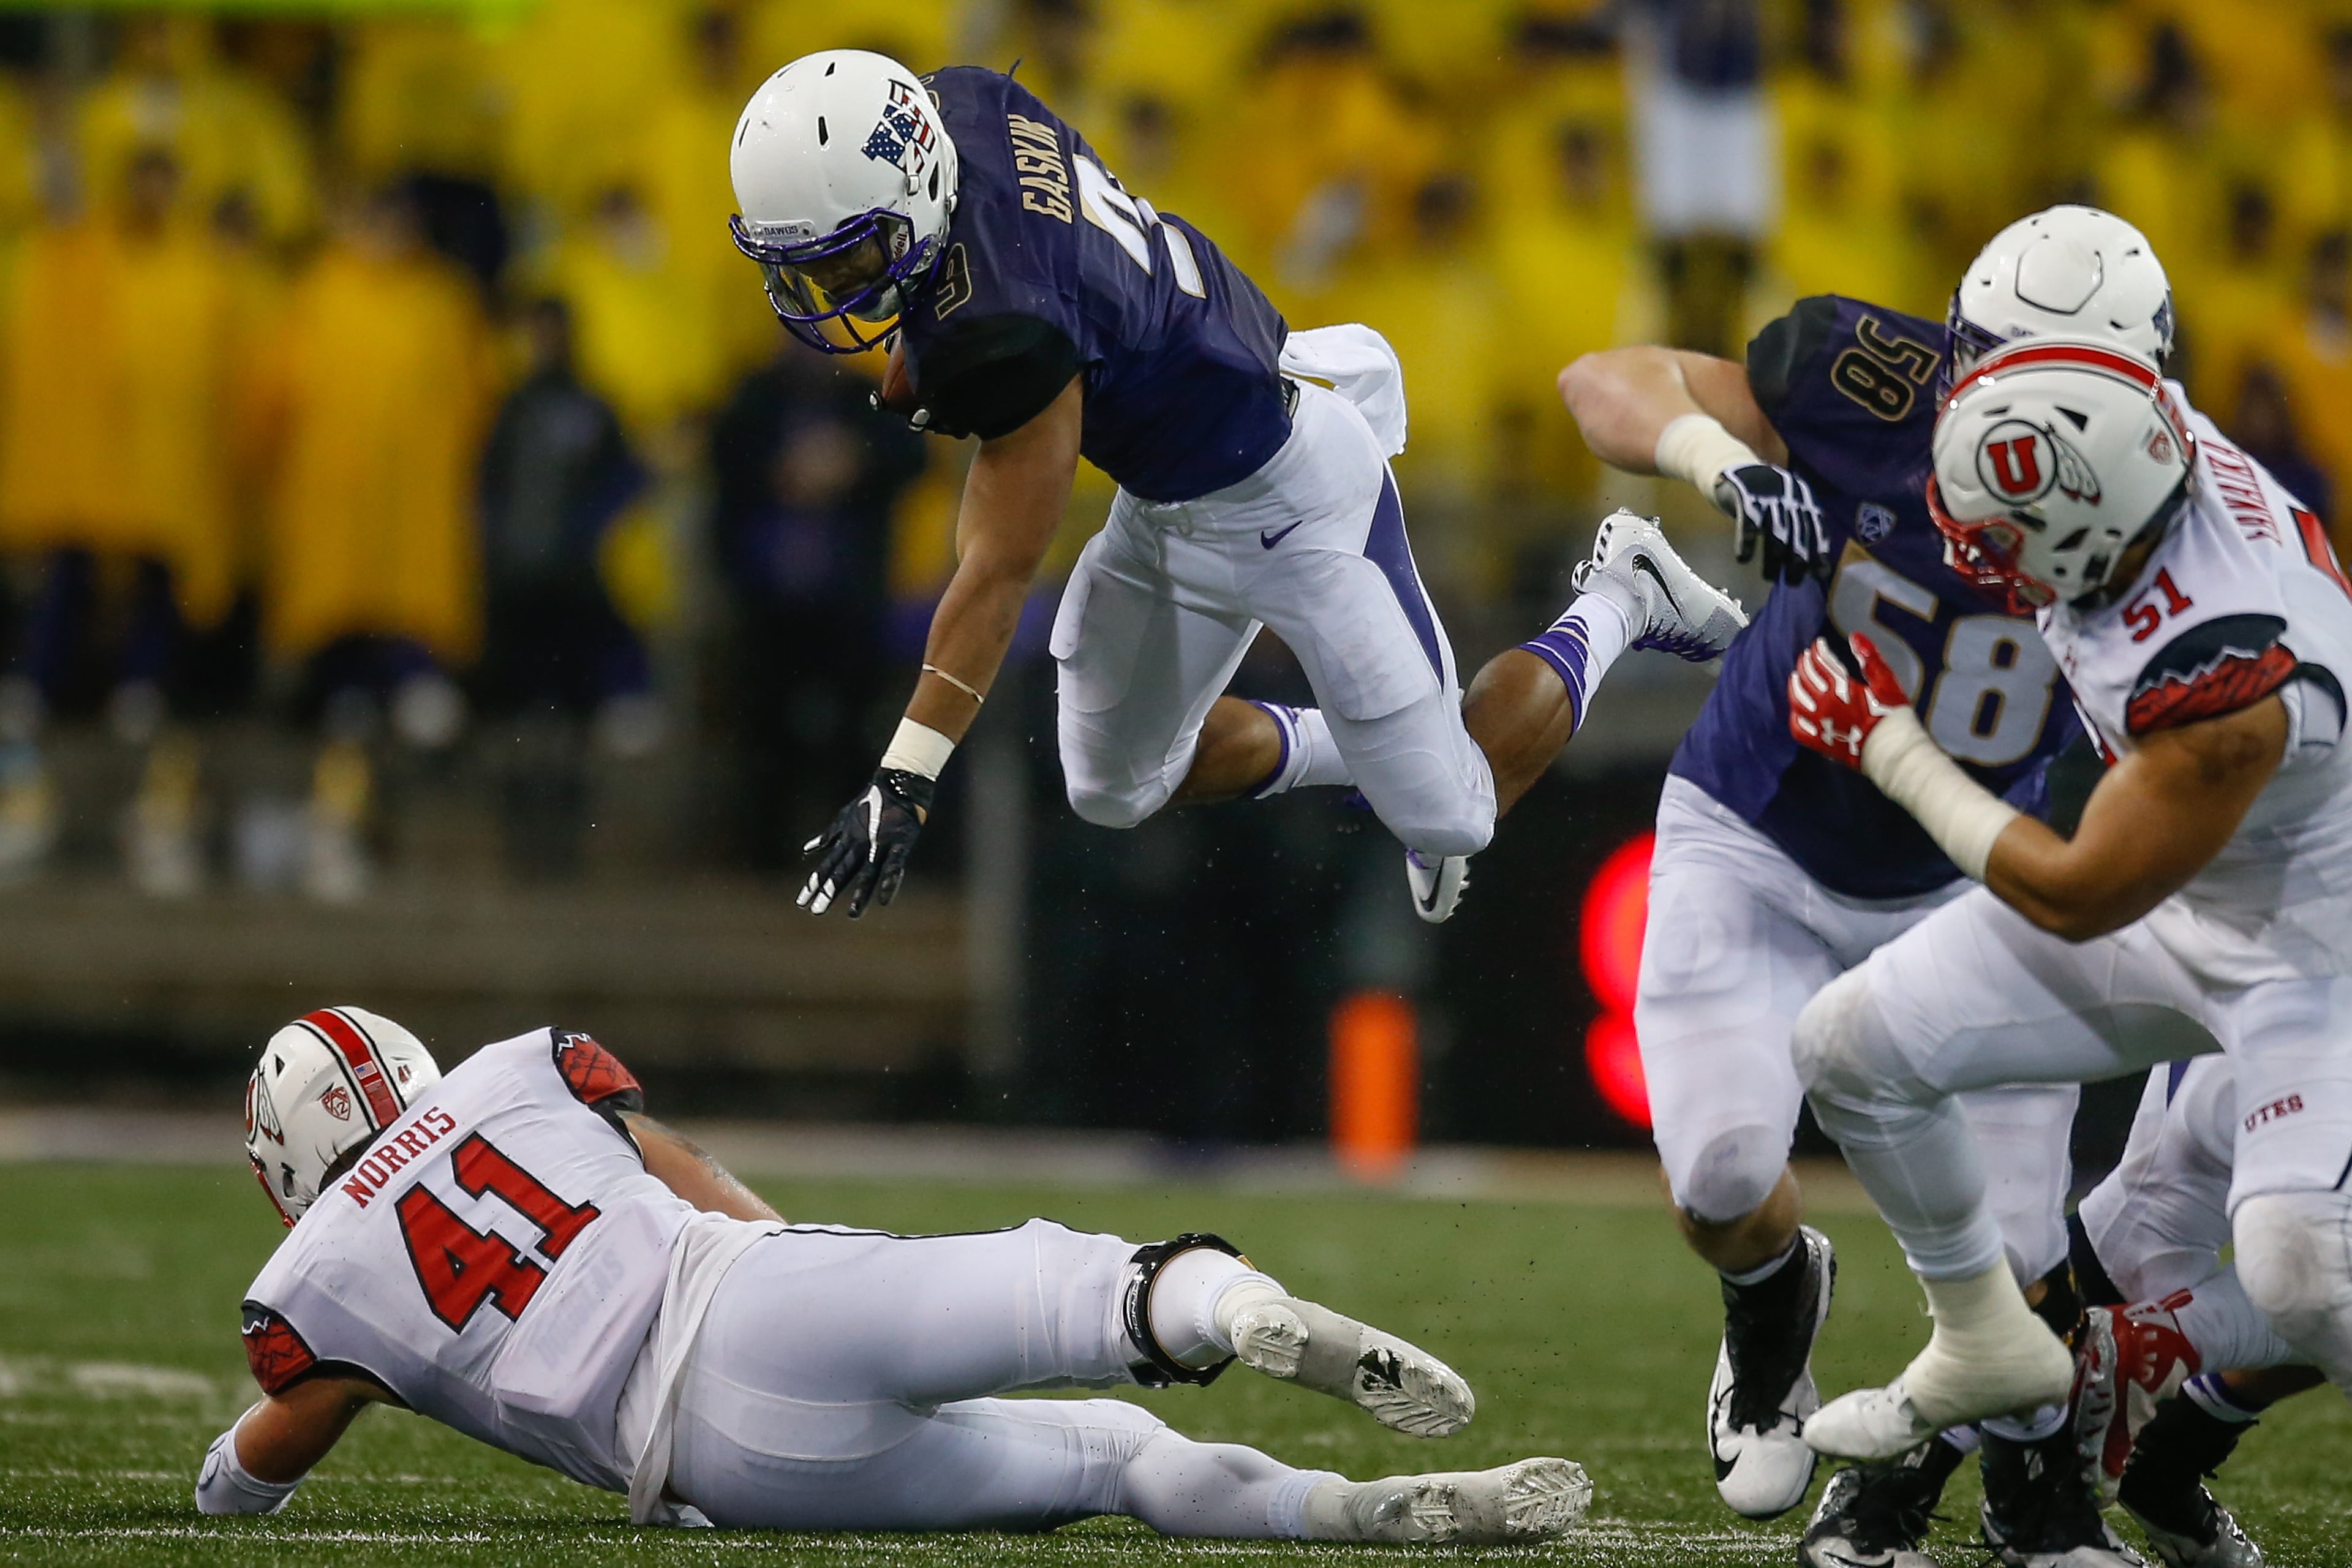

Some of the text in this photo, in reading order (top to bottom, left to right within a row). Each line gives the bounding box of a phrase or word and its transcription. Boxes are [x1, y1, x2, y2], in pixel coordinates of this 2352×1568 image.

[1006, 113, 1074, 224] GASKIN
[1830, 312, 1943, 423] 58
[1986, 435, 2041, 496] U
[1826, 537, 2060, 768] 58
[2122, 566, 2193, 643] 51
[341, 1106, 456, 1210] NORRIS
[2244, 1093, 2303, 1133] UTES
[394, 1131, 601, 1335] 41
